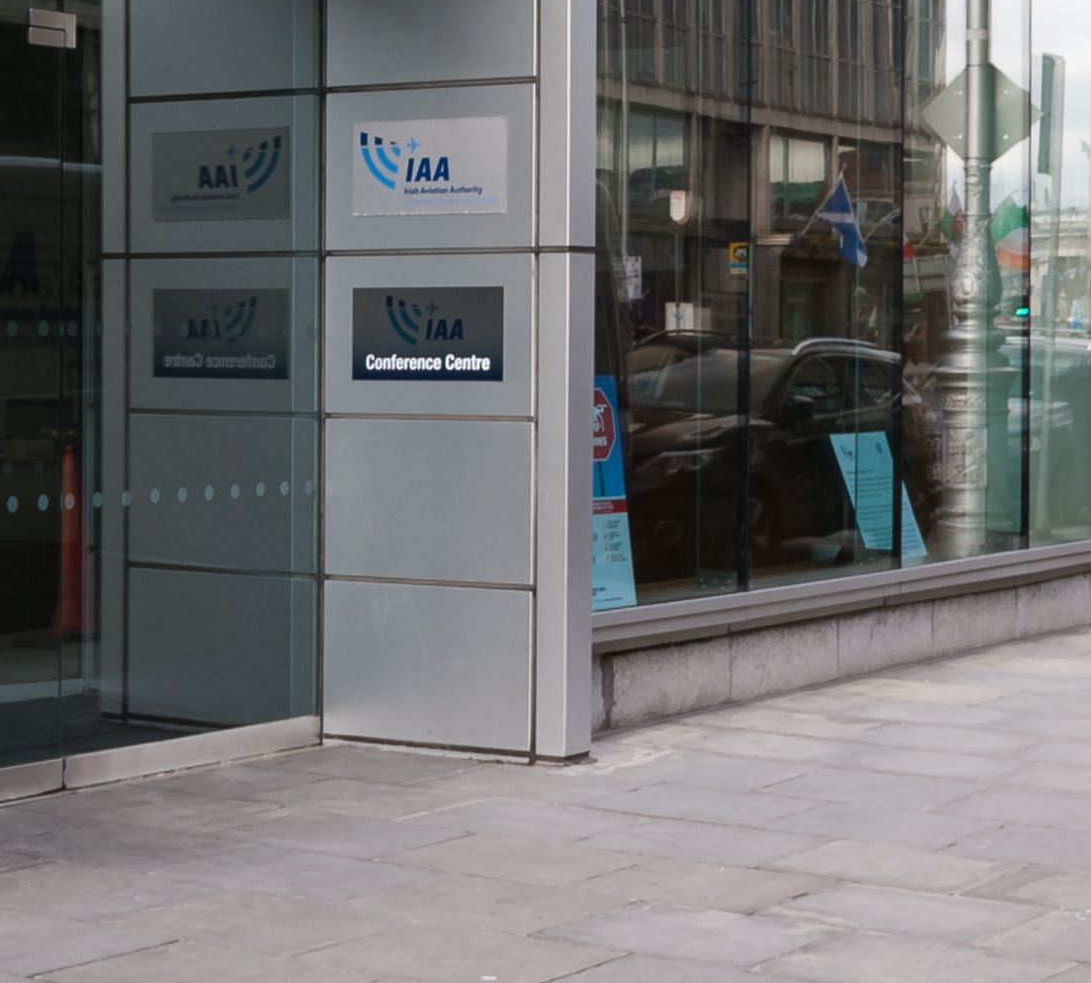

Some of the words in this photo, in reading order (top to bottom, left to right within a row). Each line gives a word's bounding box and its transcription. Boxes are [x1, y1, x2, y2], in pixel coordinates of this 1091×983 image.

[406, 156, 450, 182] IAA
[449, 185, 483, 196] Authority
[426, 318, 464, 340] IAA
[365, 353, 442, 371] Conference
[445, 353, 491, 371] Centre
